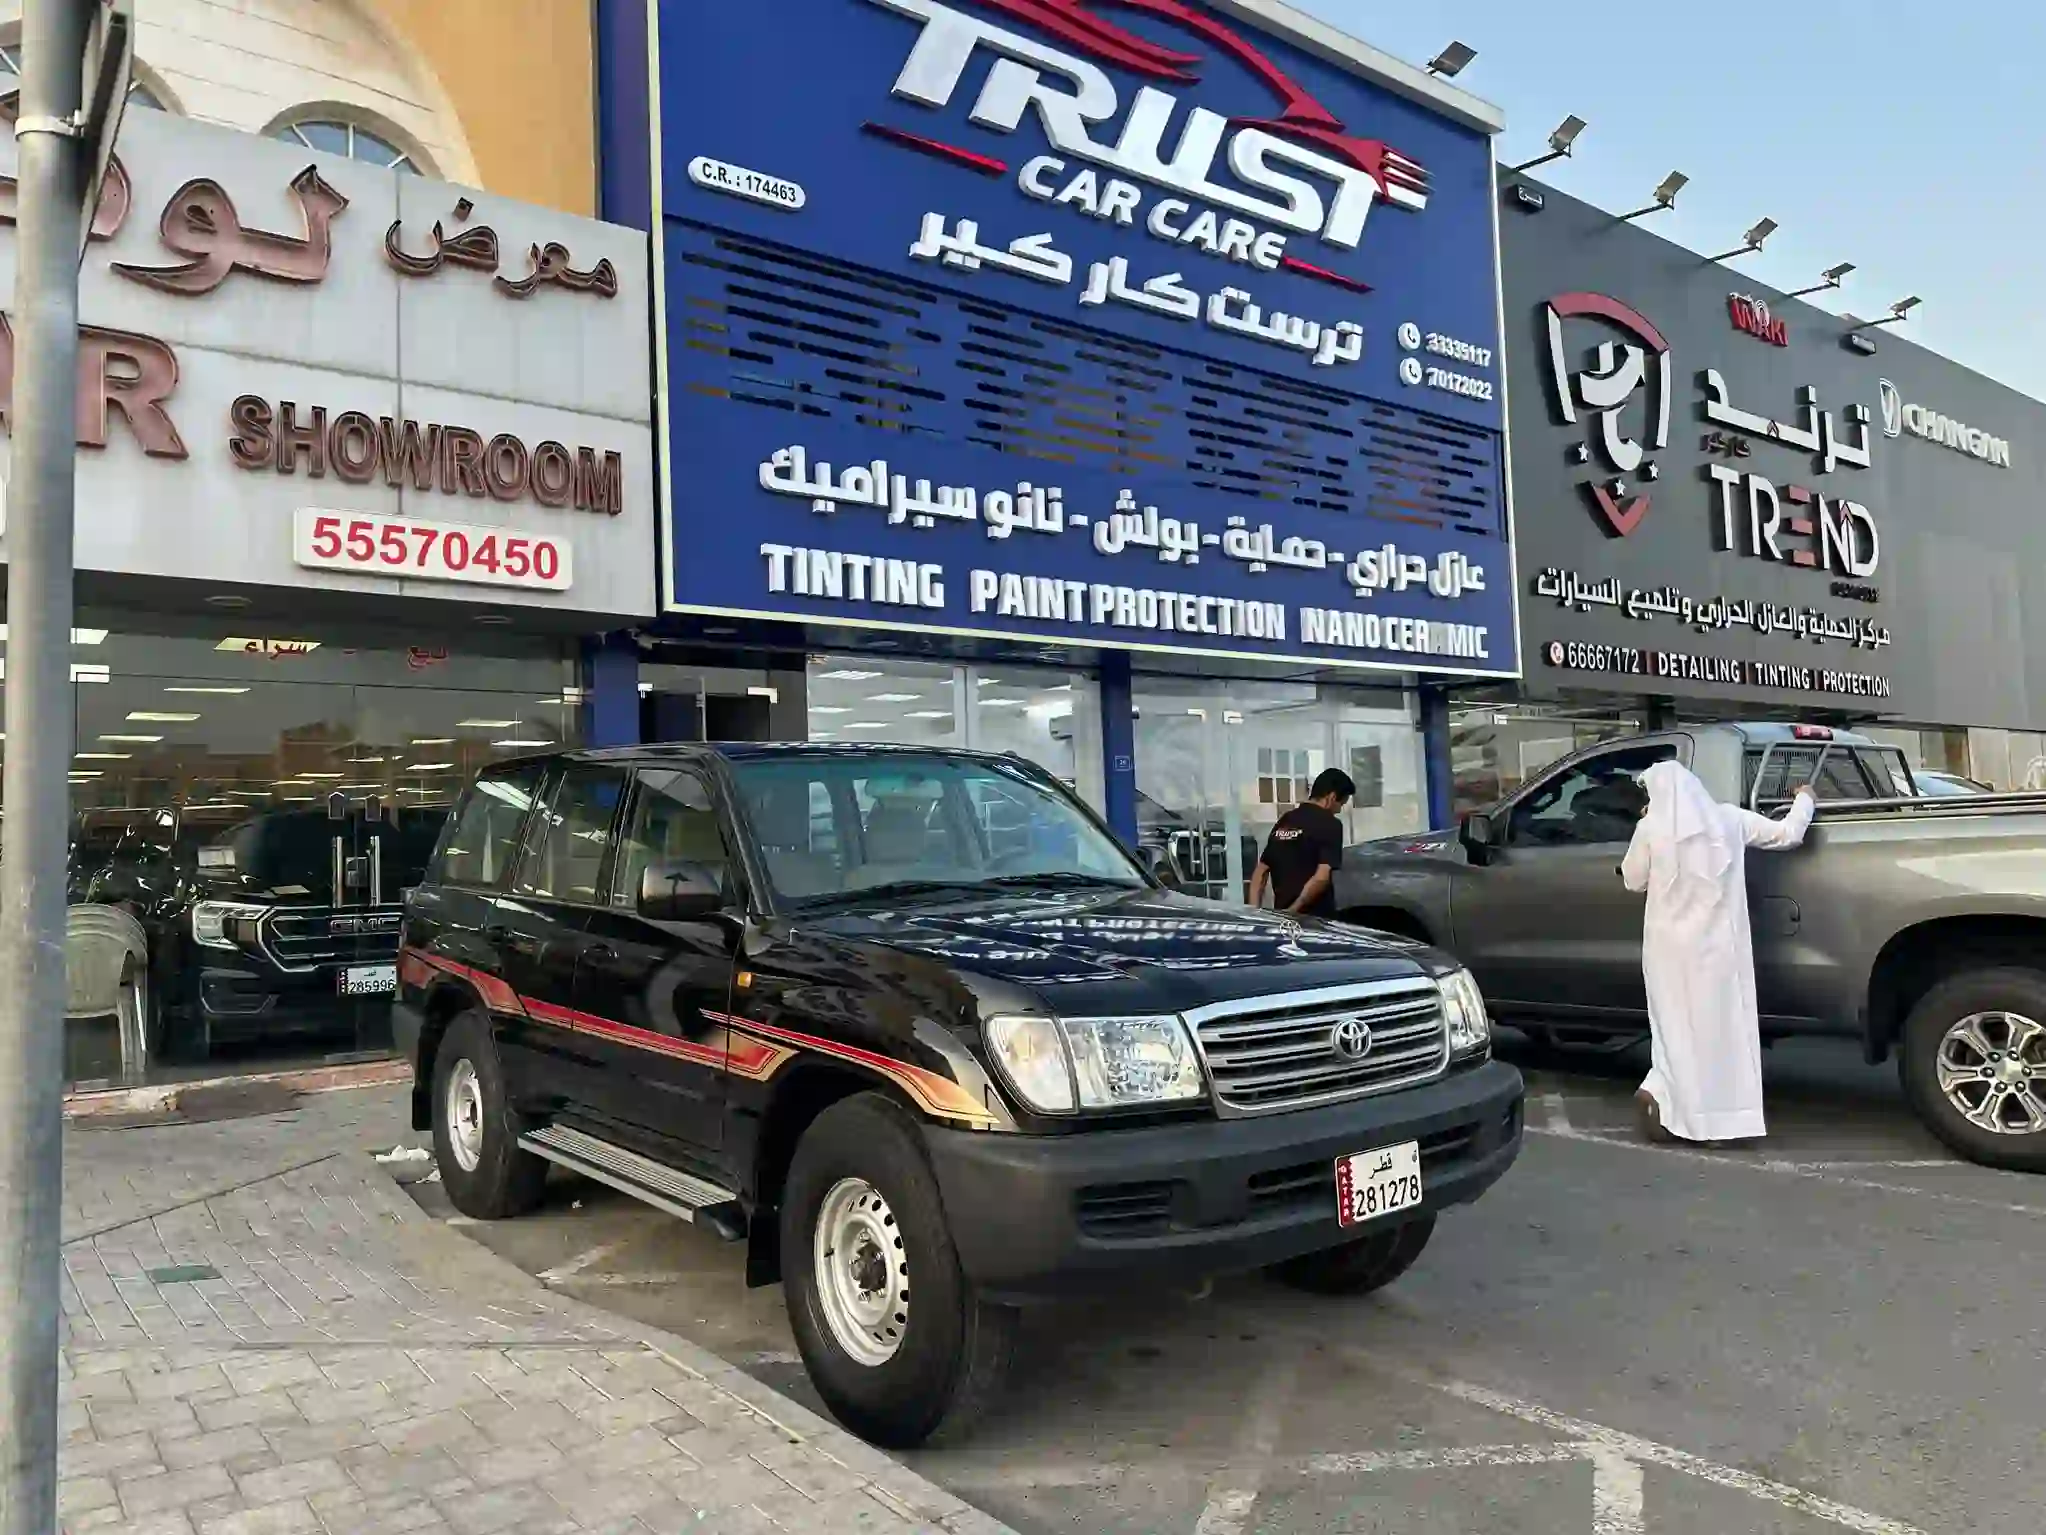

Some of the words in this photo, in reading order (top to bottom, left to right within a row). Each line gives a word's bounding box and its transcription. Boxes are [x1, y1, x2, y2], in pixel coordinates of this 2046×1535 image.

[878, 0, 1427, 250] TRUST
[745, 174, 796, 202] 174463
[1018, 155, 1141, 226] CAR
[1147, 198, 1287, 270] CARE
[385, 197, 617, 299] معرض
[909, 212, 1072, 285] كير
[1079, 255, 1199, 320] كار
[1206, 286, 1363, 366] ترست
[1707, 368, 1871, 473] ترند
[229, 394, 623, 515] SHOWROOM
[759, 444, 977, 527] سيراميك
[984, 481, 1063, 538] نانو
[1093, 488, 1200, 565] بولش
[1710, 462, 1880, 577] TREND
[311, 517, 558, 580] 55570450
[1223, 515, 1327, 573] حماية
[1347, 543, 1427, 597] حراري
[1428, 550, 1486, 599] عازل
[760, 542, 945, 607] TINTING
[970, 569, 1088, 623] PAINT
[1088, 583, 1286, 640] PROTECTION
[1299, 606, 1380, 650] NANO
[1381, 615, 1489, 659] CERAMIC
[1537, 567, 1622, 613] السيارات
[1696, 595, 1754, 634] الحراري
[1757, 602, 1807, 639] والعازل
[1809, 607, 1857, 644] الحماية
[1858, 617, 1891, 650] مركز
[1567, 641, 1640, 674] 66667172
[1657, 651, 1741, 684] DETAILING
[1755, 662, 1810, 690] TINTING
[1822, 669, 1891, 698] PROTECTION
[1355, 1173, 1420, 1218] 281278
